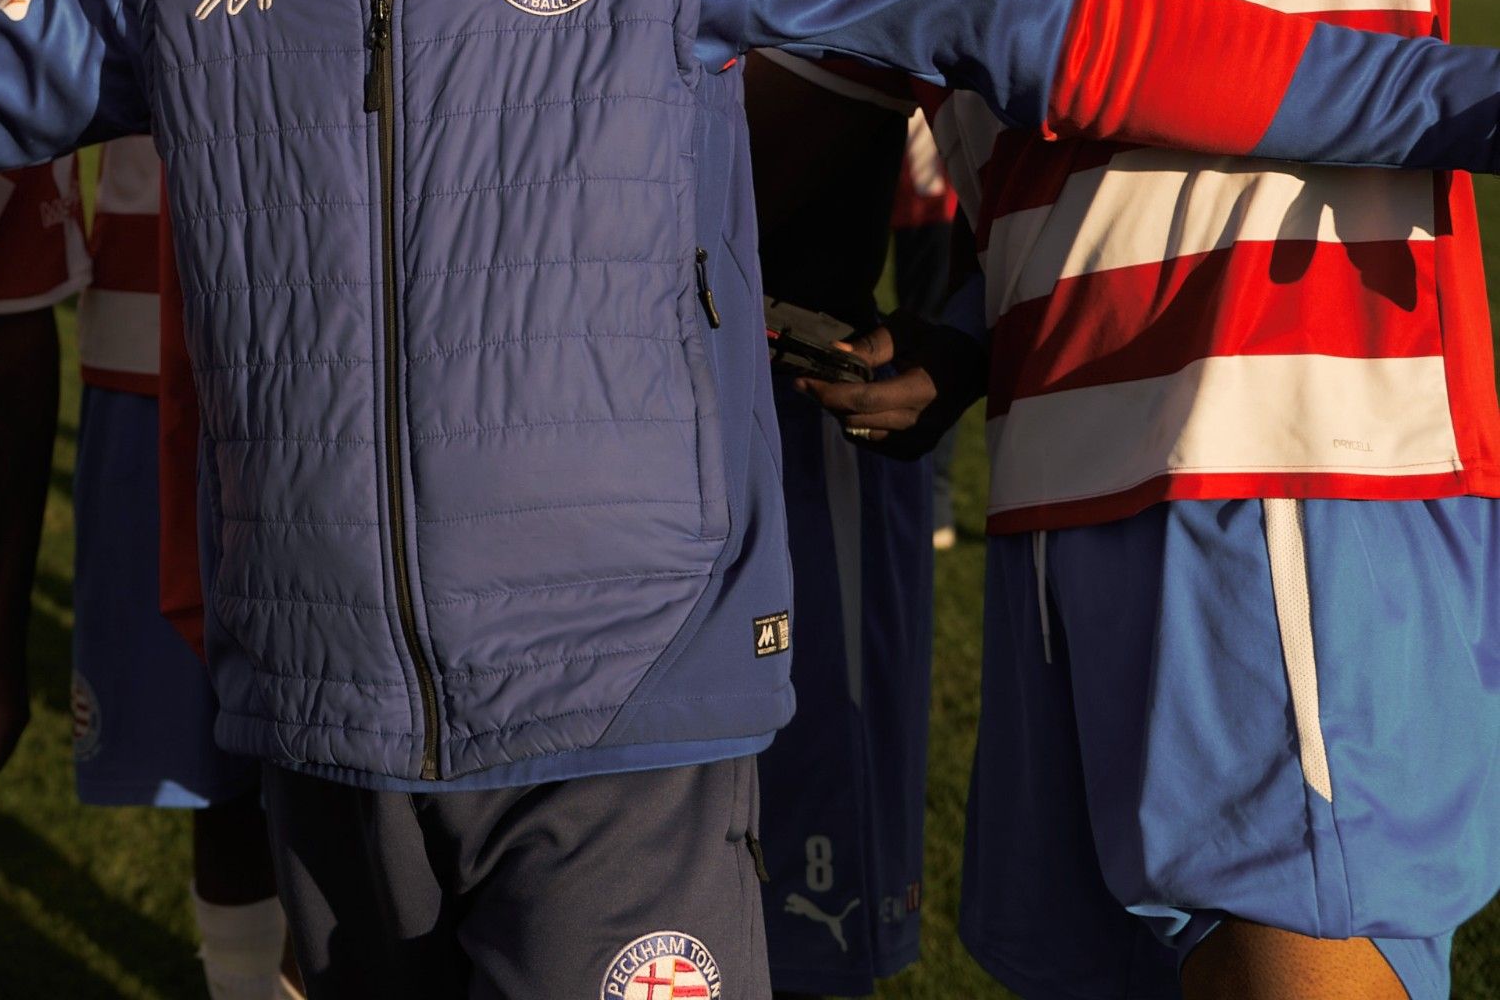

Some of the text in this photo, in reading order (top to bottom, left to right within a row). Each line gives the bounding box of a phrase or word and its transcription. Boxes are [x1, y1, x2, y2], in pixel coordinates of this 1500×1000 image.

[805, 834, 834, 892] 8
[607, 936, 721, 999] PECKHAM TOWN
